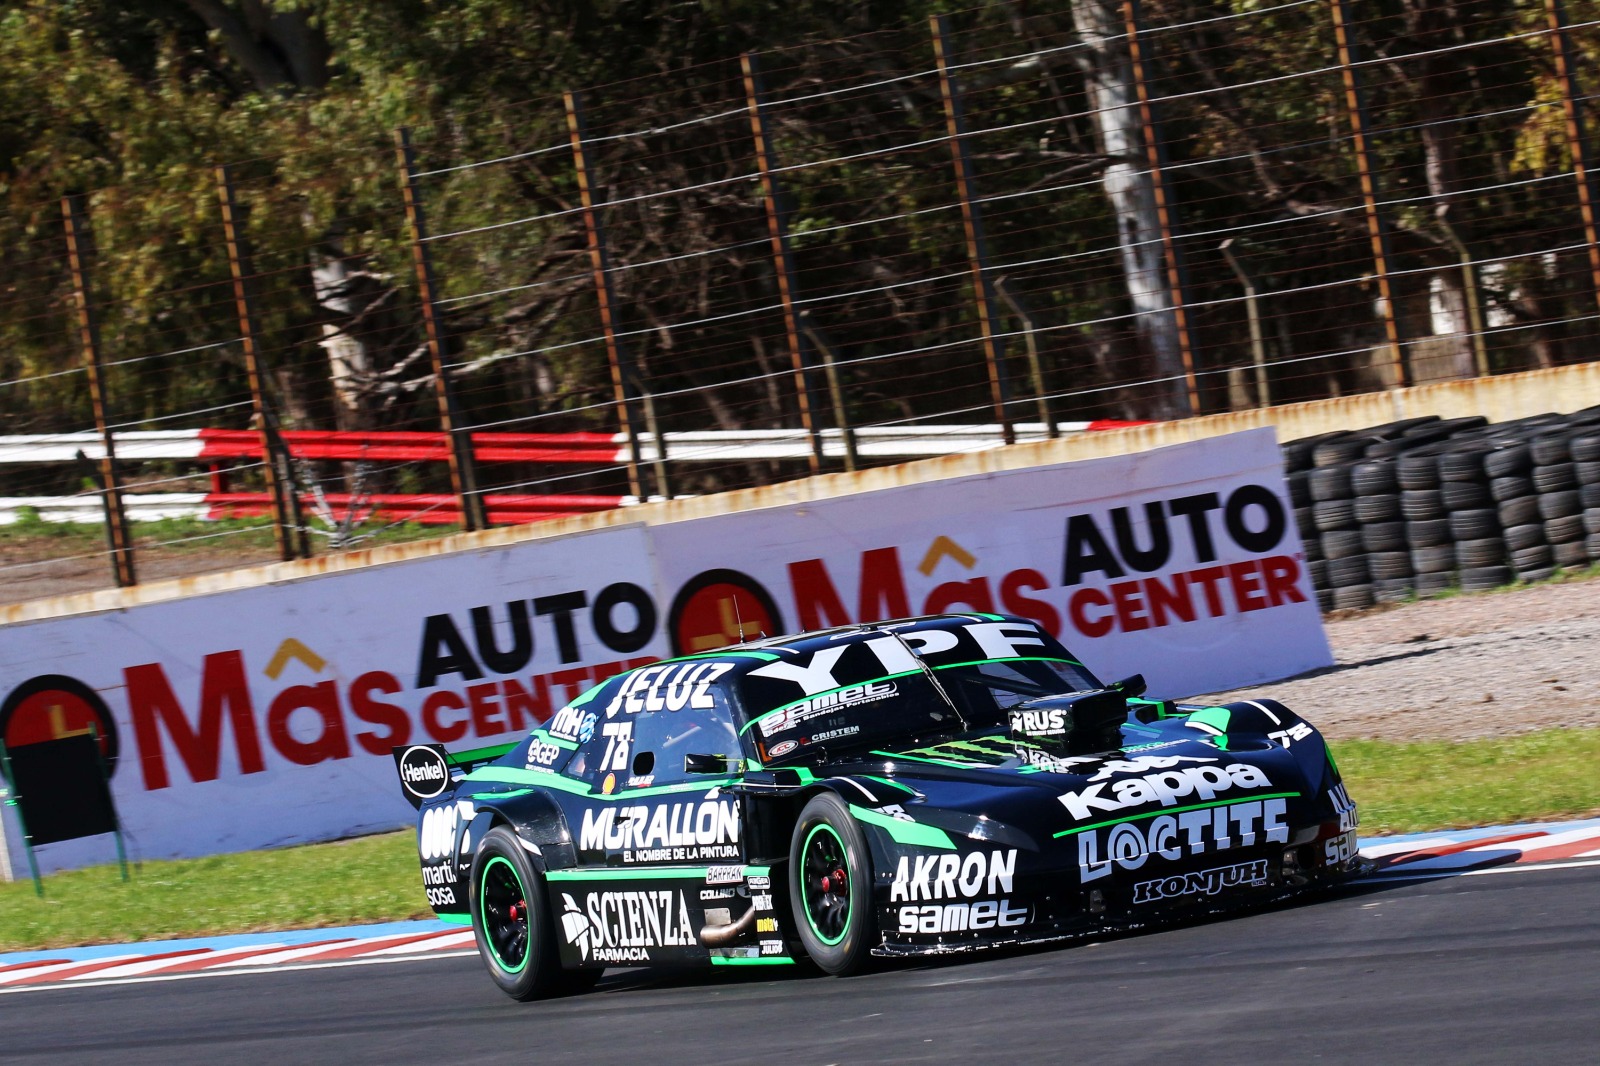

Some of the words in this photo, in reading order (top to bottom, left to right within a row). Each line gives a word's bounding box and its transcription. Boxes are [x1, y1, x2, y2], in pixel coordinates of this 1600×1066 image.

[1062, 484, 1287, 587] AUTO
[1069, 555, 1310, 639] CENTER
[415, 582, 659, 689] AUTO
[747, 622, 1046, 696] YPF
[421, 656, 662, 744] CENT
[605, 662, 736, 719] JELUZ
[760, 682, 891, 728] samet
[811, 725, 860, 741] CRISTEM
[1022, 708, 1065, 731] RUS
[403, 759, 444, 783] Henkel
[600, 721, 634, 771] 78
[1057, 763, 1273, 821] Kappa
[579, 786, 741, 851] MURALLÓN
[1078, 797, 1290, 884] LOCTITE
[624, 850, 635, 863] EL
[636, 847, 672, 862] NOMBRE
[673, 847, 686, 860] DE
[687, 846, 700, 859] LA
[700, 845, 740, 858] PINTURA
[707, 866, 742, 881] BARPRAN
[890, 849, 1018, 903] AKRON
[426, 886, 457, 907] sosa
[1133, 859, 1268, 904] KONJUH
[586, 888, 698, 948] SCIENZA
[898, 899, 1028, 934] samet
[593, 947, 650, 961] FARMACIA
